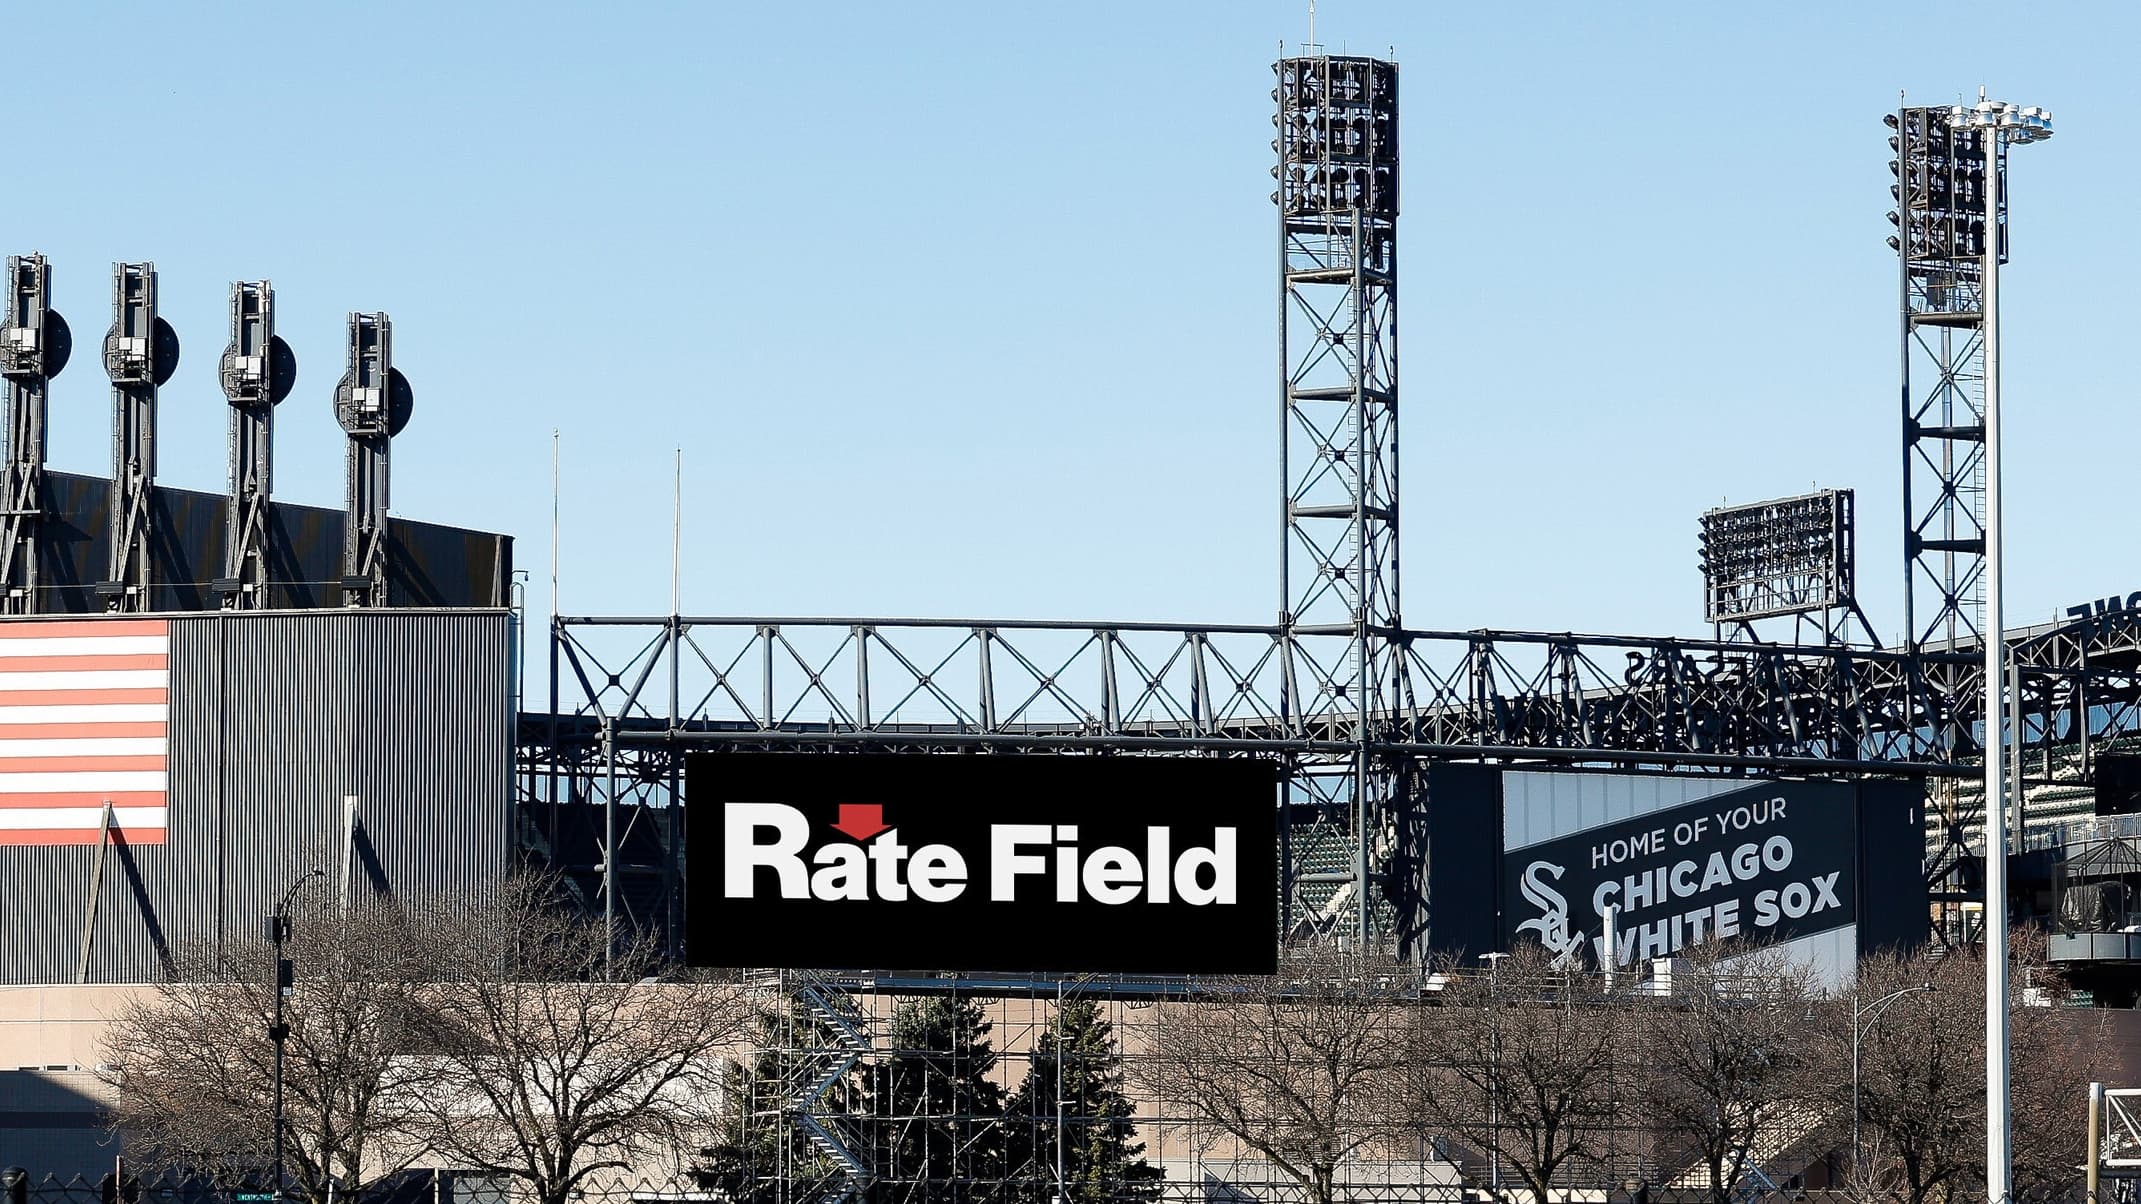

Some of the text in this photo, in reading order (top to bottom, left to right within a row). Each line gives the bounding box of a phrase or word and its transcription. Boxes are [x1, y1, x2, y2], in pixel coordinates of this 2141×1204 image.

[724, 802, 1237, 905] Rate Field
[1591, 796, 1787, 870] HOME OF YOUR
[1592, 835, 1793, 918] CHICAGO
[1593, 870, 1842, 968] WHITE SOX
